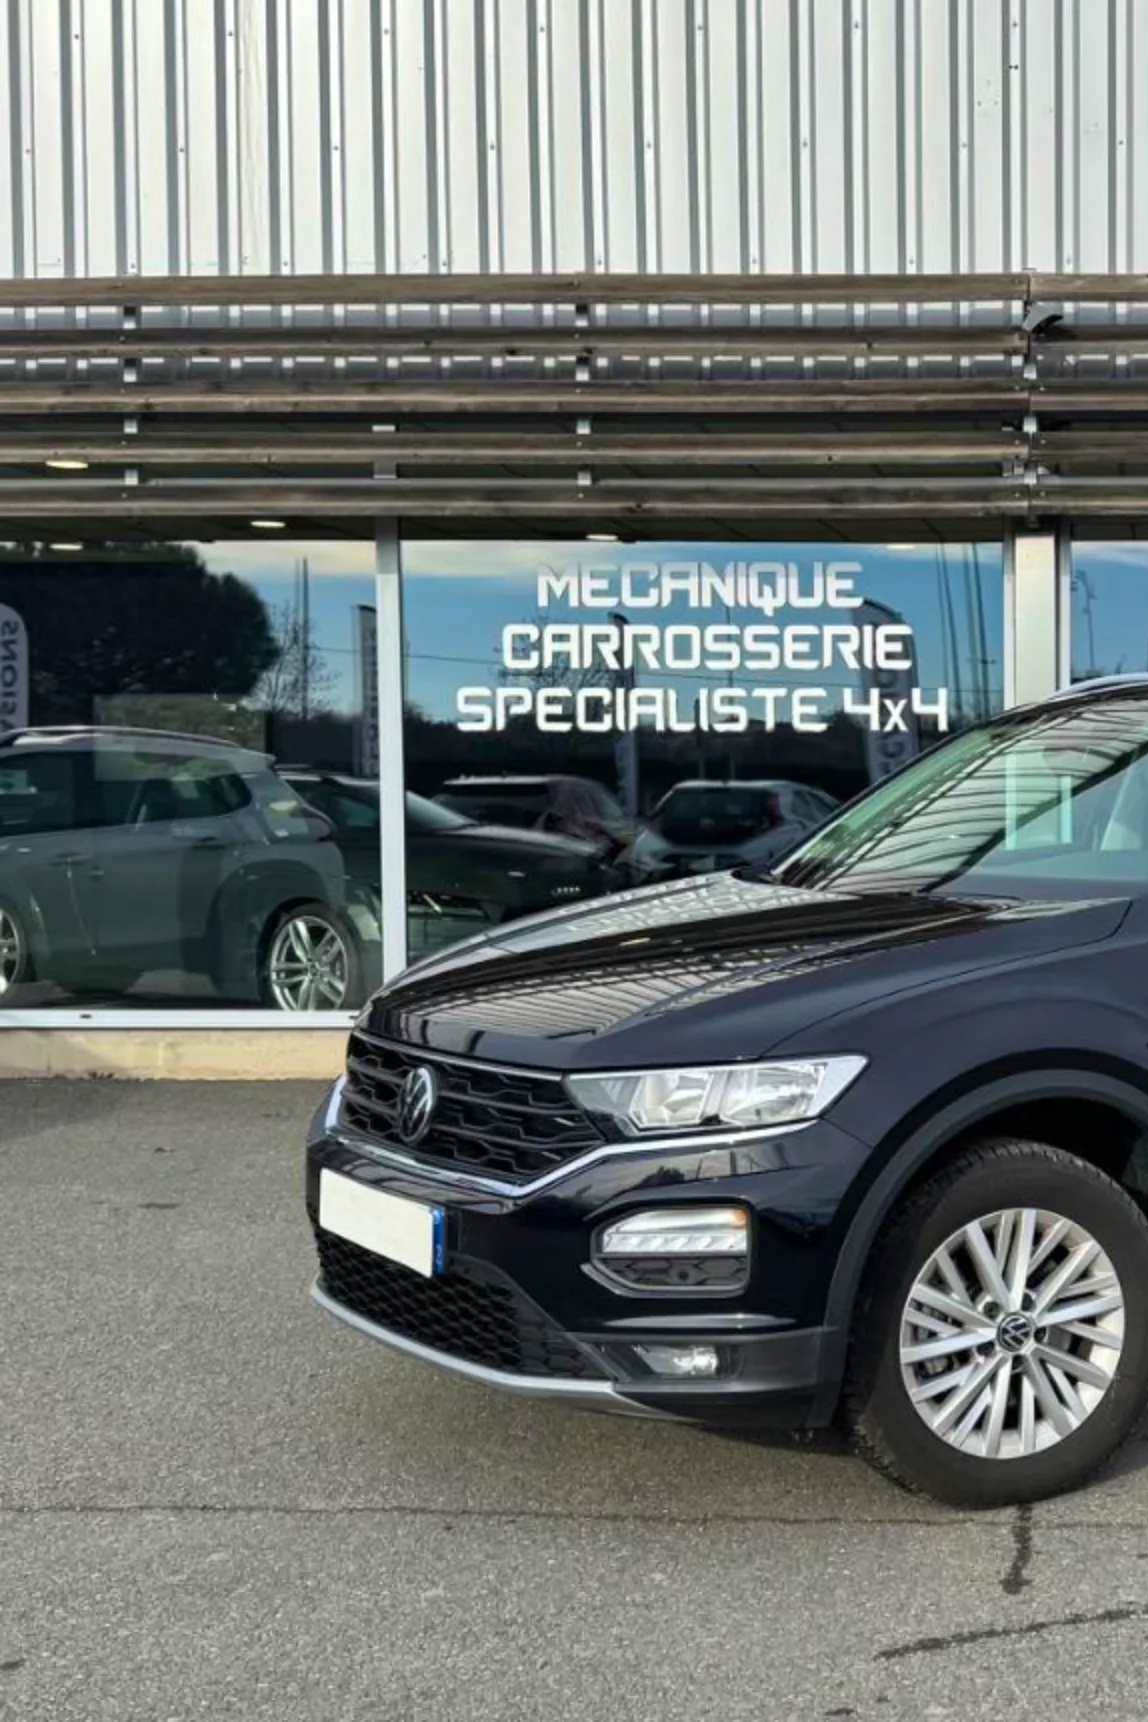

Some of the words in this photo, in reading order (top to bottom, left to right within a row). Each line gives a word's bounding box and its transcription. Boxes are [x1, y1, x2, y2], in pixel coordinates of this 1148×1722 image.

[537, 561, 864, 616] MECANIQUE
[502, 623, 913, 670] CARROSSERIE
[456, 686, 828, 733] SPECIALISTE
[843, 686, 949, 733] 4x4
